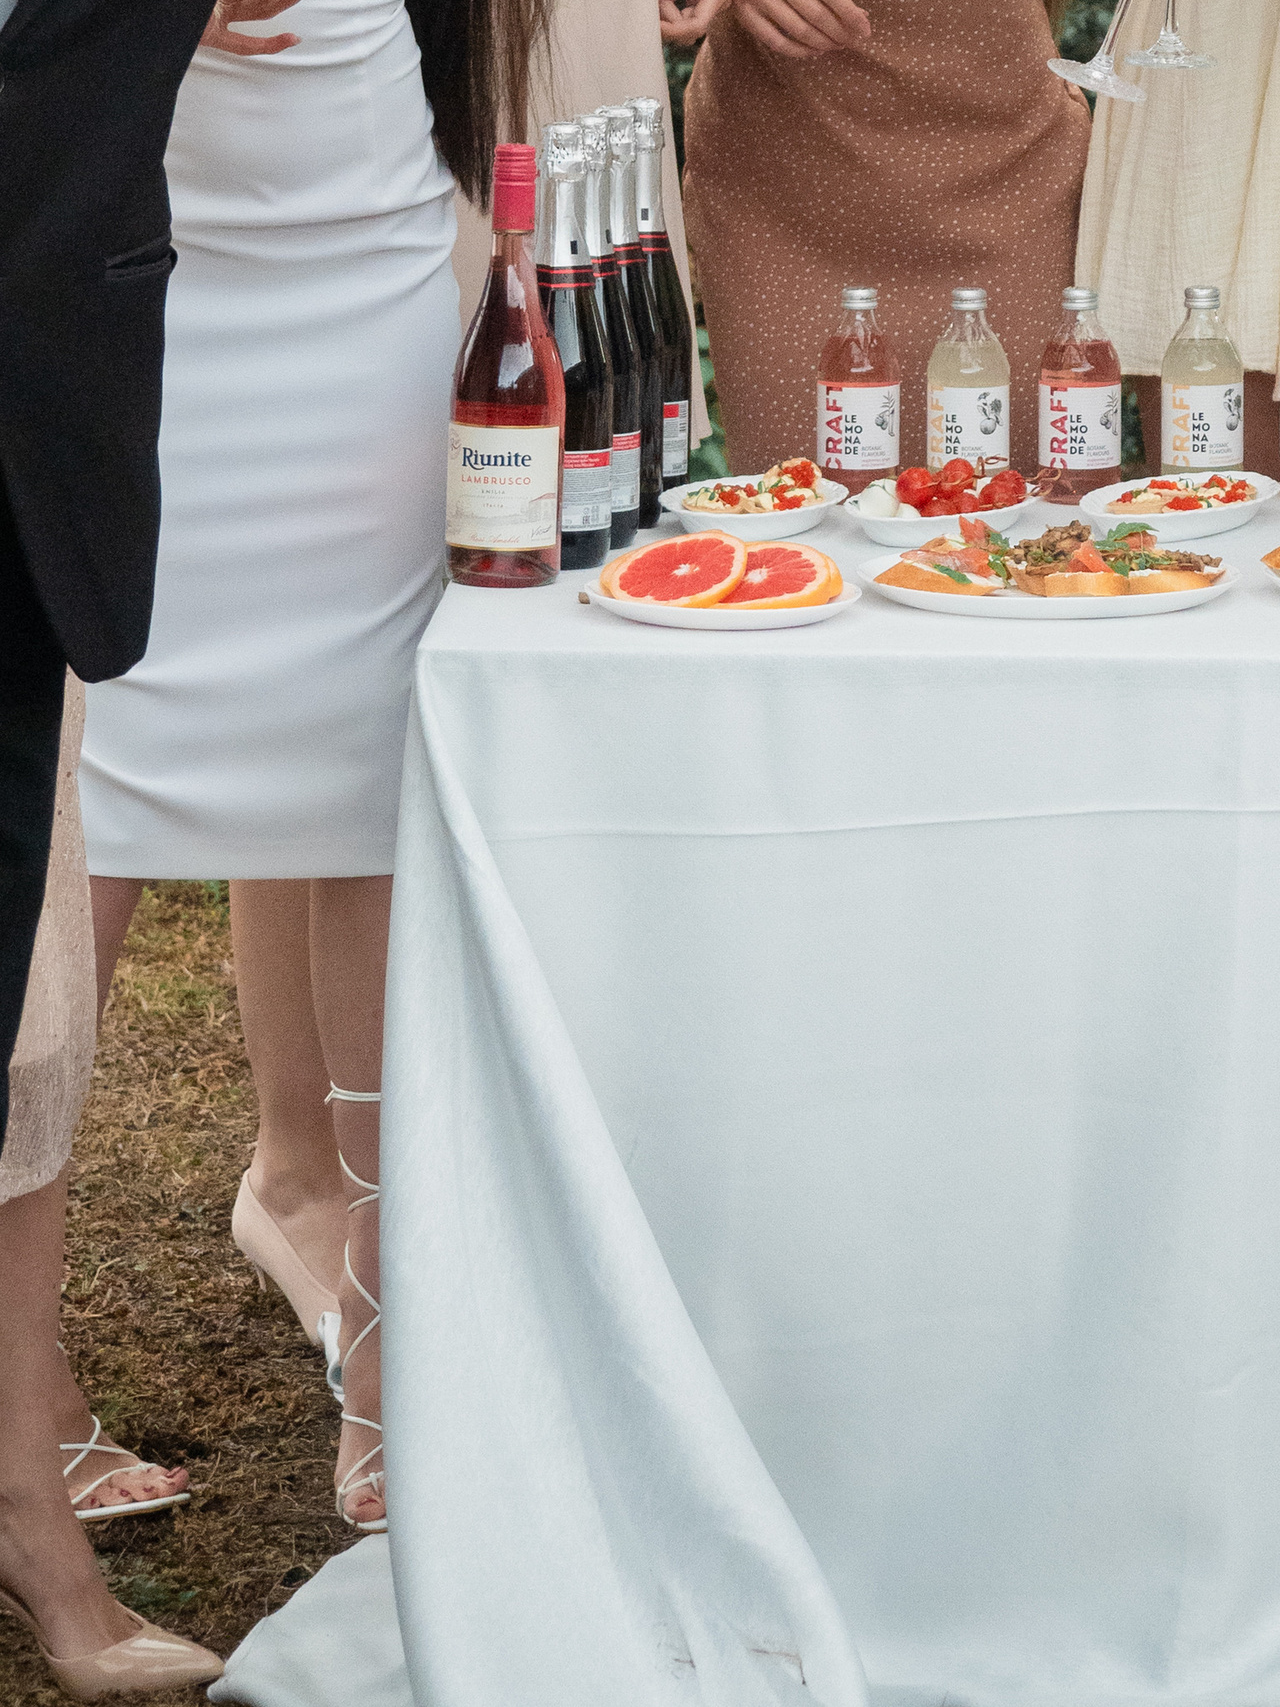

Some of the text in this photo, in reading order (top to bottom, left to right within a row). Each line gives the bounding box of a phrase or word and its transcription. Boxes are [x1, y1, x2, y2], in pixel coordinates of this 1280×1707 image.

[845, 415, 857, 423] LE
[946, 414, 956, 422] LE
[1070, 414, 1082, 423] LE
[1192, 412, 1204, 421] LE
[845, 425, 863, 434] MO
[946, 425, 962, 434] MO
[1070, 425, 1088, 434] MO
[1192, 423, 1210, 432] MO
[845, 436, 861, 444] NA
[946, 436, 961, 444] NA
[1070, 436, 1086, 444] NA
[1192, 434, 1209, 442] NA
[845, 446, 858, 455] DE
[946, 446, 958, 454] DE
[1070, 446, 1084, 455] DE
[1192, 444, 1207, 453] DE
[462, 447, 532, 470] Riunite
[461, 474, 531, 486] LAMBRUSCO
